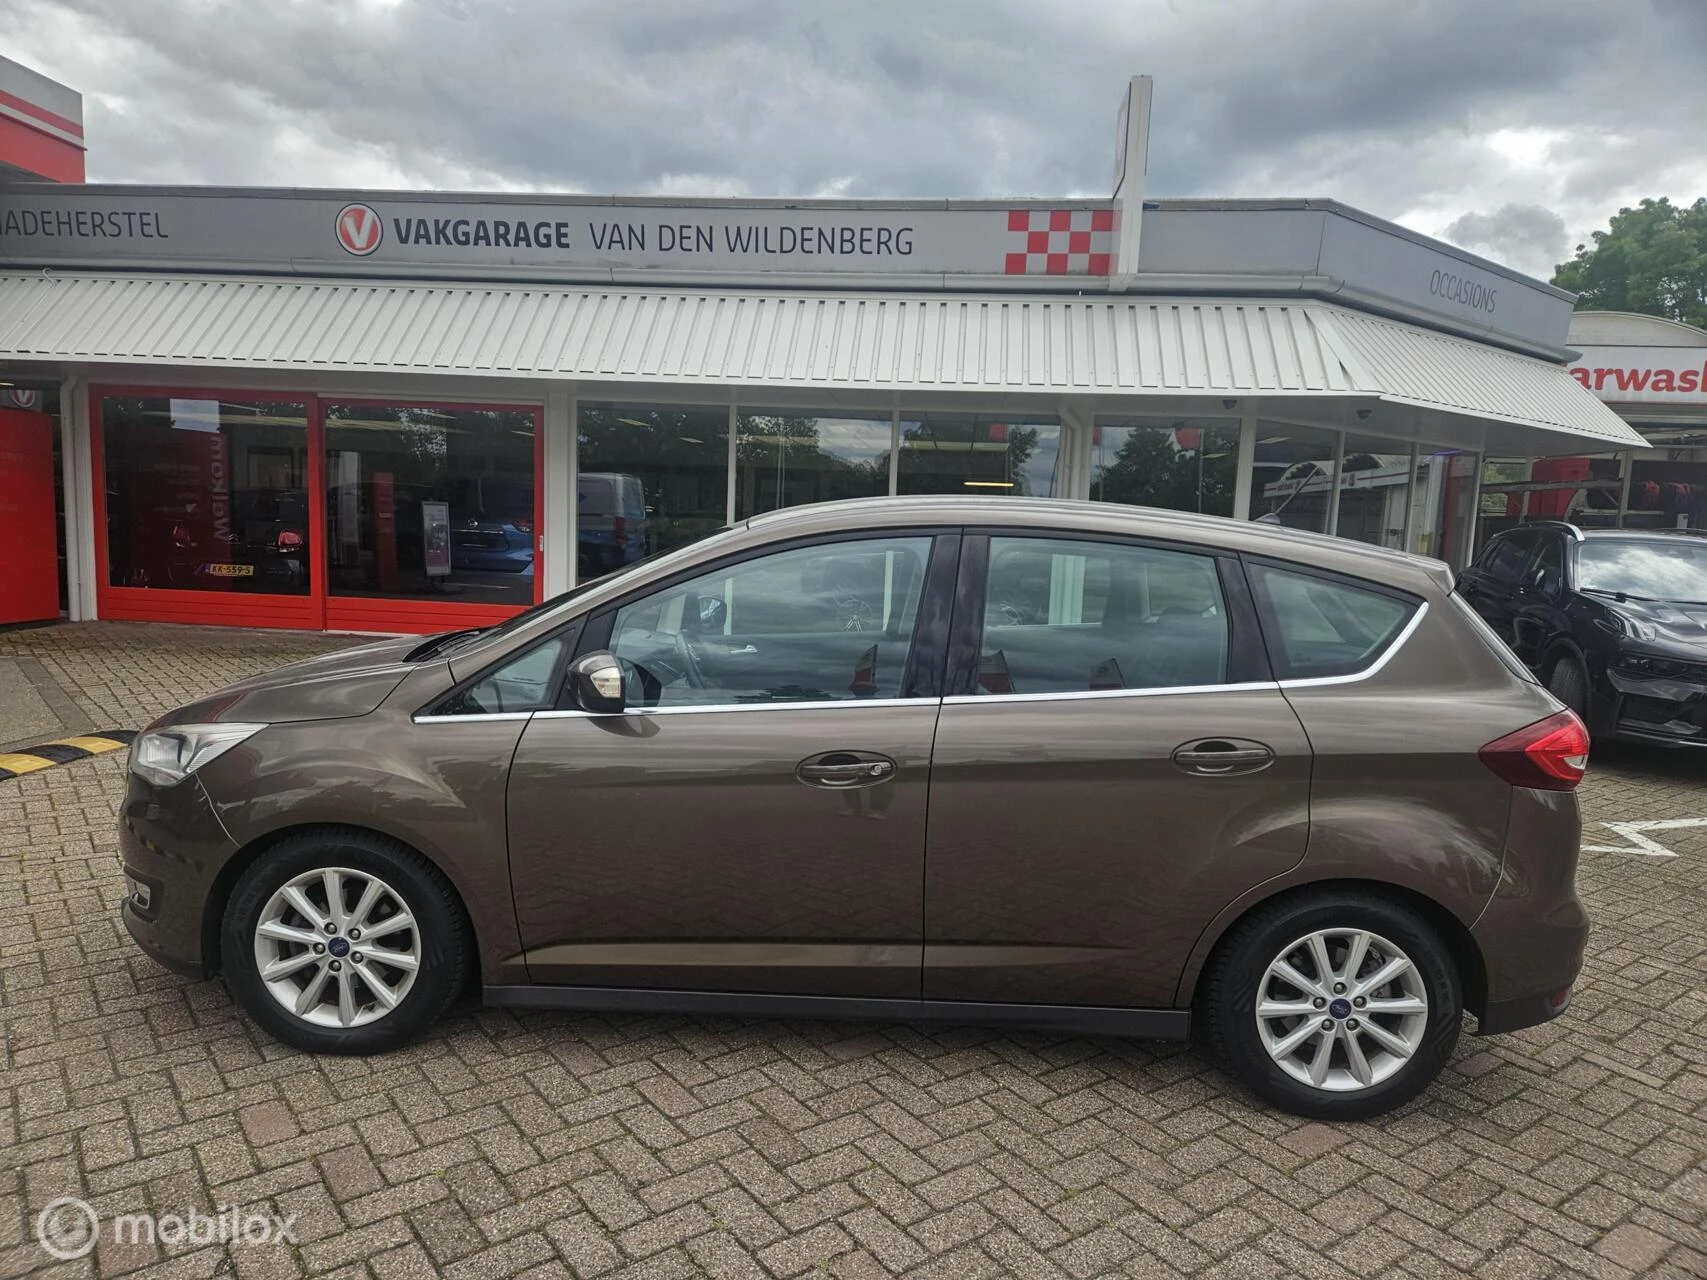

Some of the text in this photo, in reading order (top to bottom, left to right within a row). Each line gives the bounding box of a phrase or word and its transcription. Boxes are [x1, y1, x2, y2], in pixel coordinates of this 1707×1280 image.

[0, 210, 169, 238] ADEHERSTEL
[343, 207, 377, 249] V
[393, 218, 914, 256] VAKGARAGE VAN DEN WILDENBERG
[1430, 269, 1498, 313] OCCASIONS
[1561, 361, 1707, 393] arwas
[211, 565, 251, 575] KK-559-S
